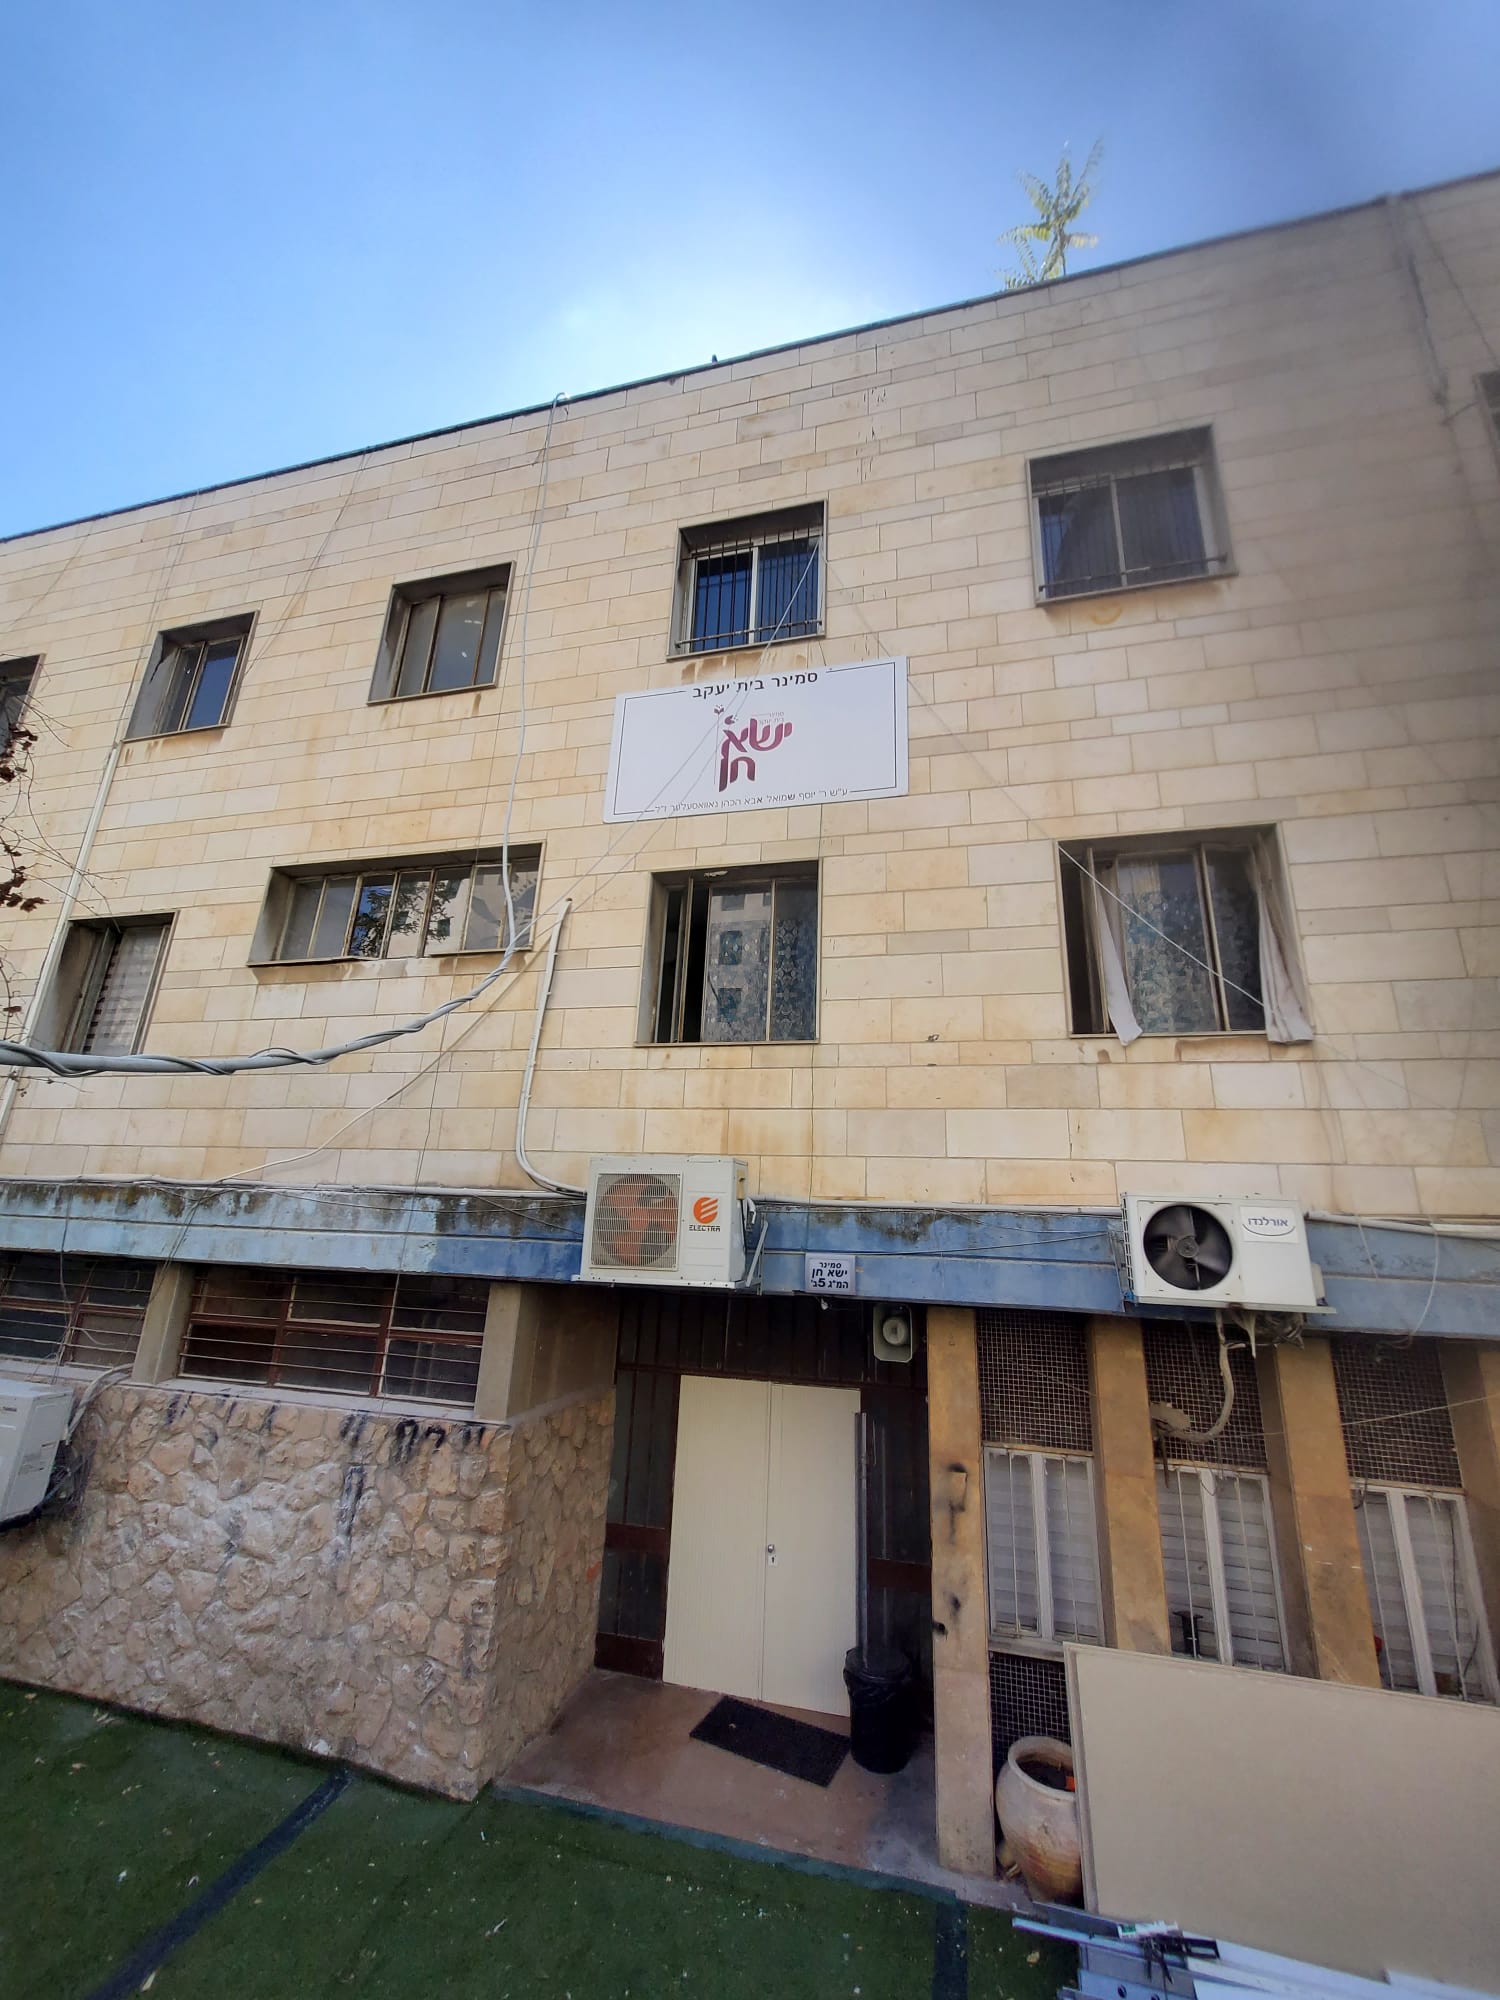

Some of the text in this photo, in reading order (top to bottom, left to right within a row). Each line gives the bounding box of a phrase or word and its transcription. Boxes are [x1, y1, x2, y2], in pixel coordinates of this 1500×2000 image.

[692, 672, 818, 699] סמינר בית יעקב
[721, 718, 792, 759] ישא
[719, 756, 755, 792] חן
[744, 796, 762, 806] אבא
[767, 793, 795, 803] שמואל
[799, 791, 815, 801] יוסף
[721, 799, 741, 809] הכהן
[1248, 1217, 1288, 1227] אורלנדו
[811, 1268, 848, 1279] ישא חן
